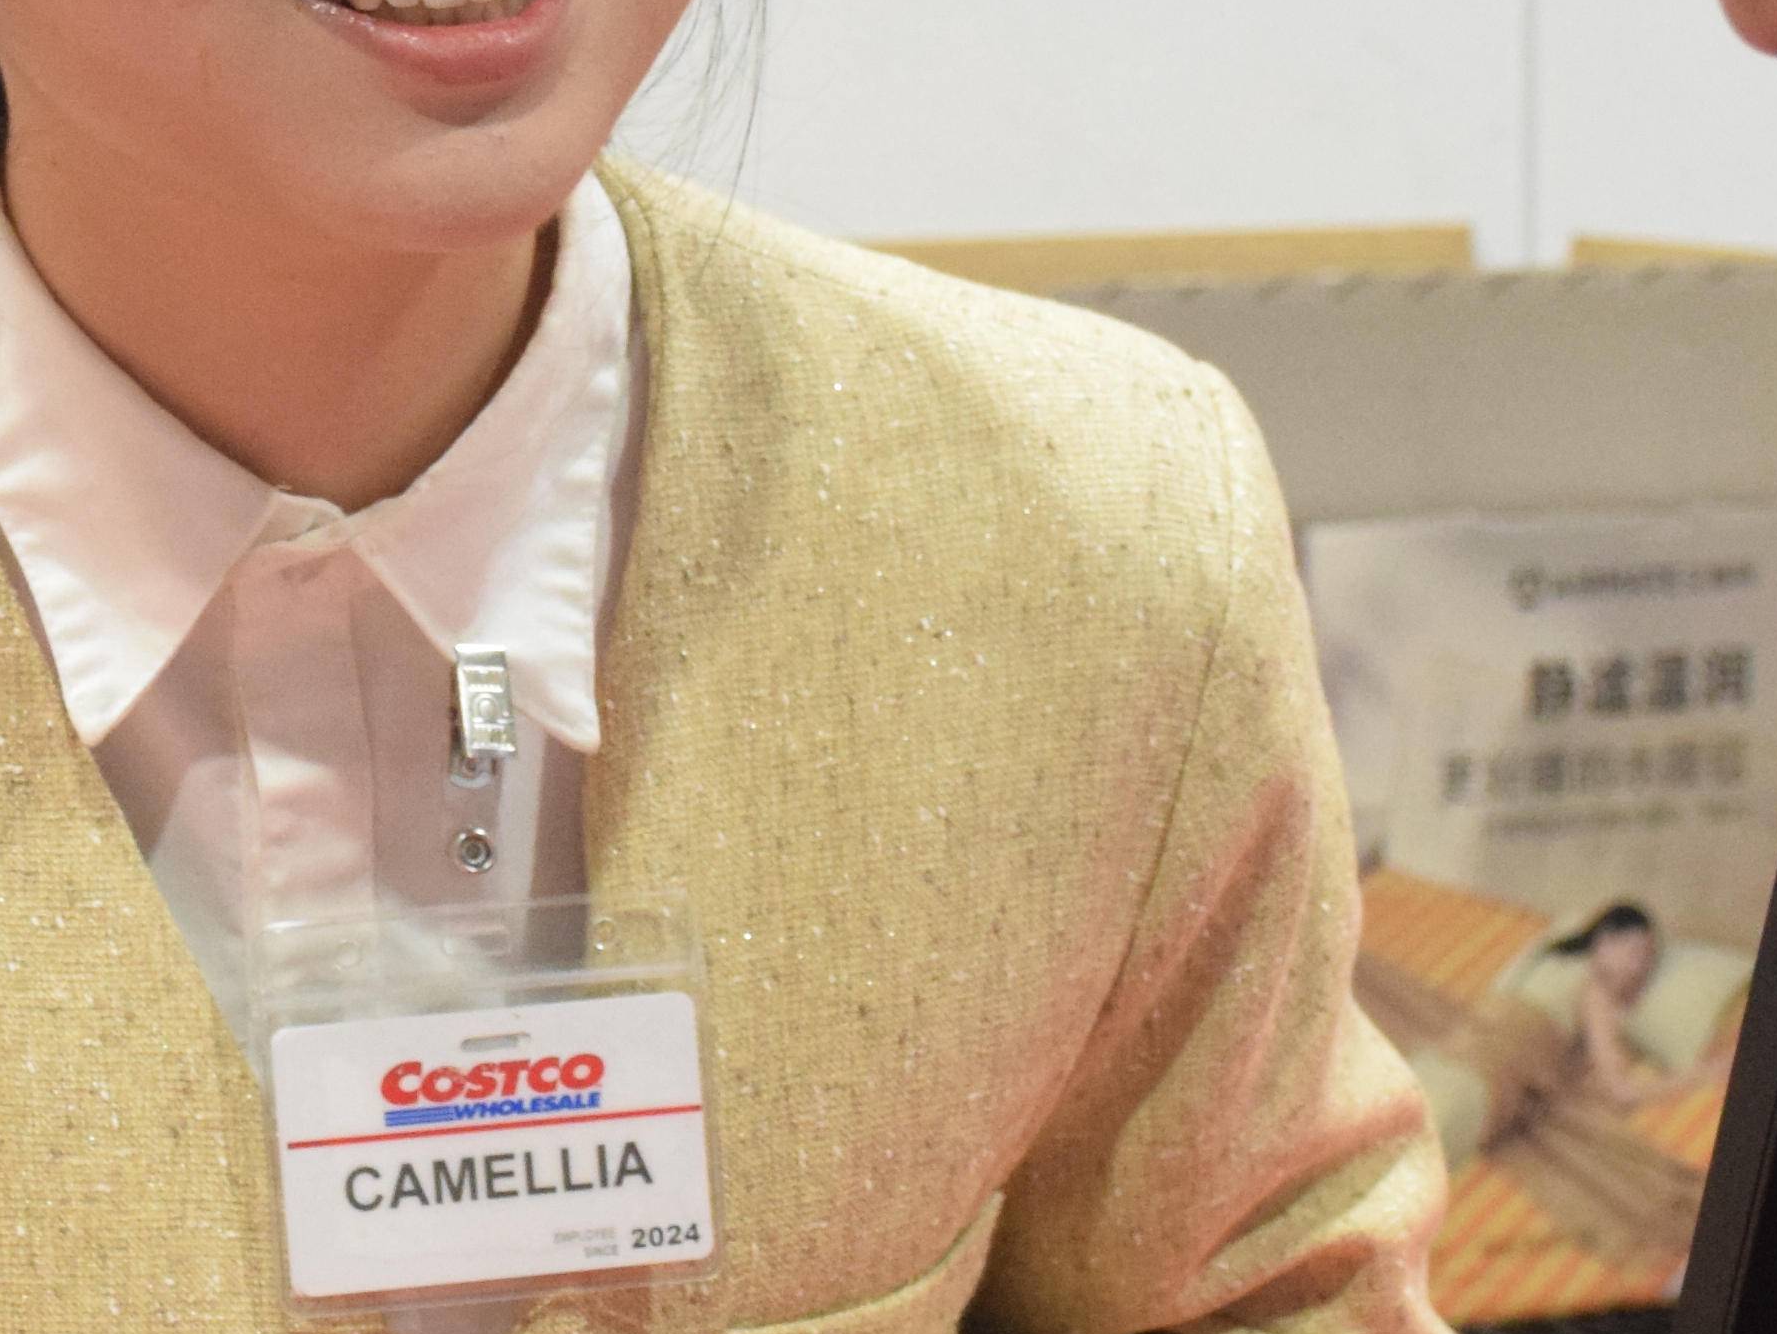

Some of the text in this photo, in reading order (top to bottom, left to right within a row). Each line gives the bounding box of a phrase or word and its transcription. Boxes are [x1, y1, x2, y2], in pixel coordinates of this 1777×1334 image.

[379, 1053, 604, 1106] COSTCO
[453, 1091, 601, 1121] WHOLESALE
[344, 1140, 653, 1213] CAMELLIA
[630, 1222, 701, 1249] 2024
